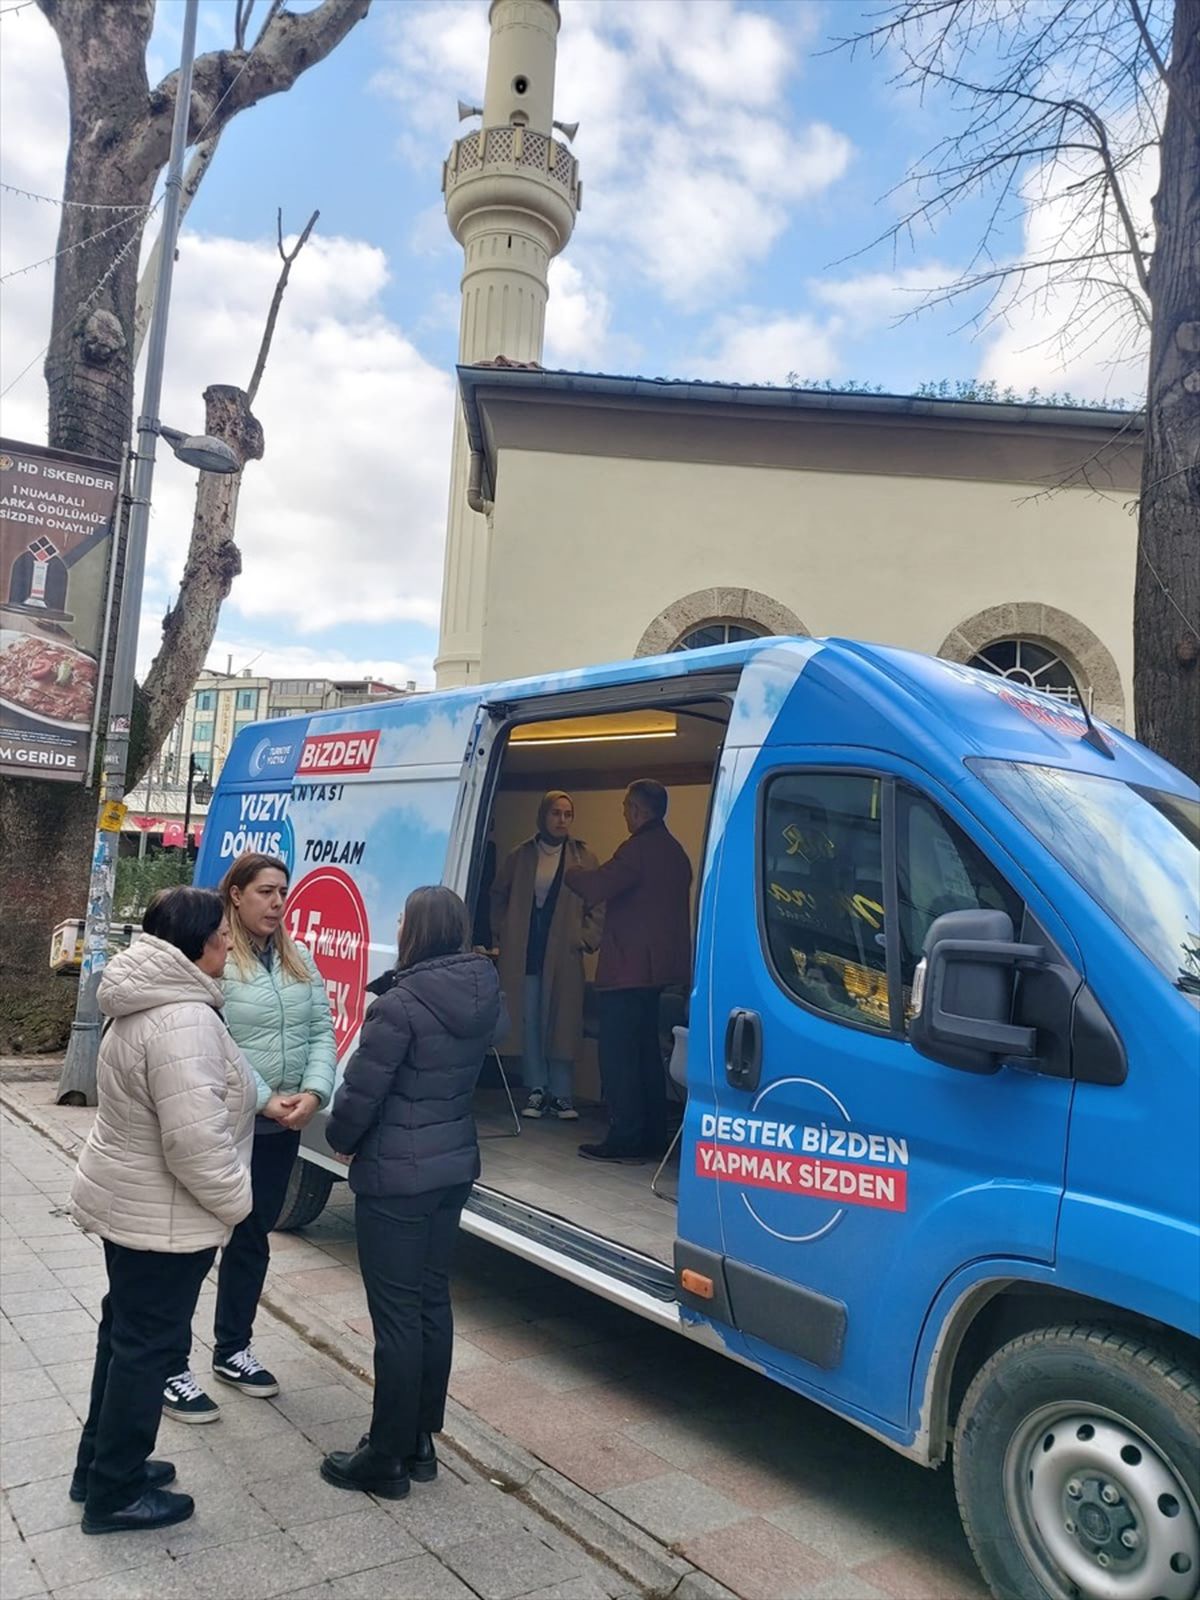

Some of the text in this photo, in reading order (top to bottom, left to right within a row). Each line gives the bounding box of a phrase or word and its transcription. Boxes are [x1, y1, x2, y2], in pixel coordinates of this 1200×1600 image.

[17, 461, 114, 491] HD İSKENDER
[20, 486, 85, 508] NUMARALI
[0, 508, 94, 535] SİZDEN ONAYLI!
[37, 502, 107, 525] ÖDÜLÜMÜZ
[15, 749, 77, 768] GERİDE
[300, 738, 375, 768] BİZDEN
[303, 839, 366, 865] TOPLAM
[317, 926, 361, 961] MİLYON
[701, 1113, 909, 1166] DESTEK BİZDEN
[700, 1147, 895, 1202] YAPMAK SİZDEN
